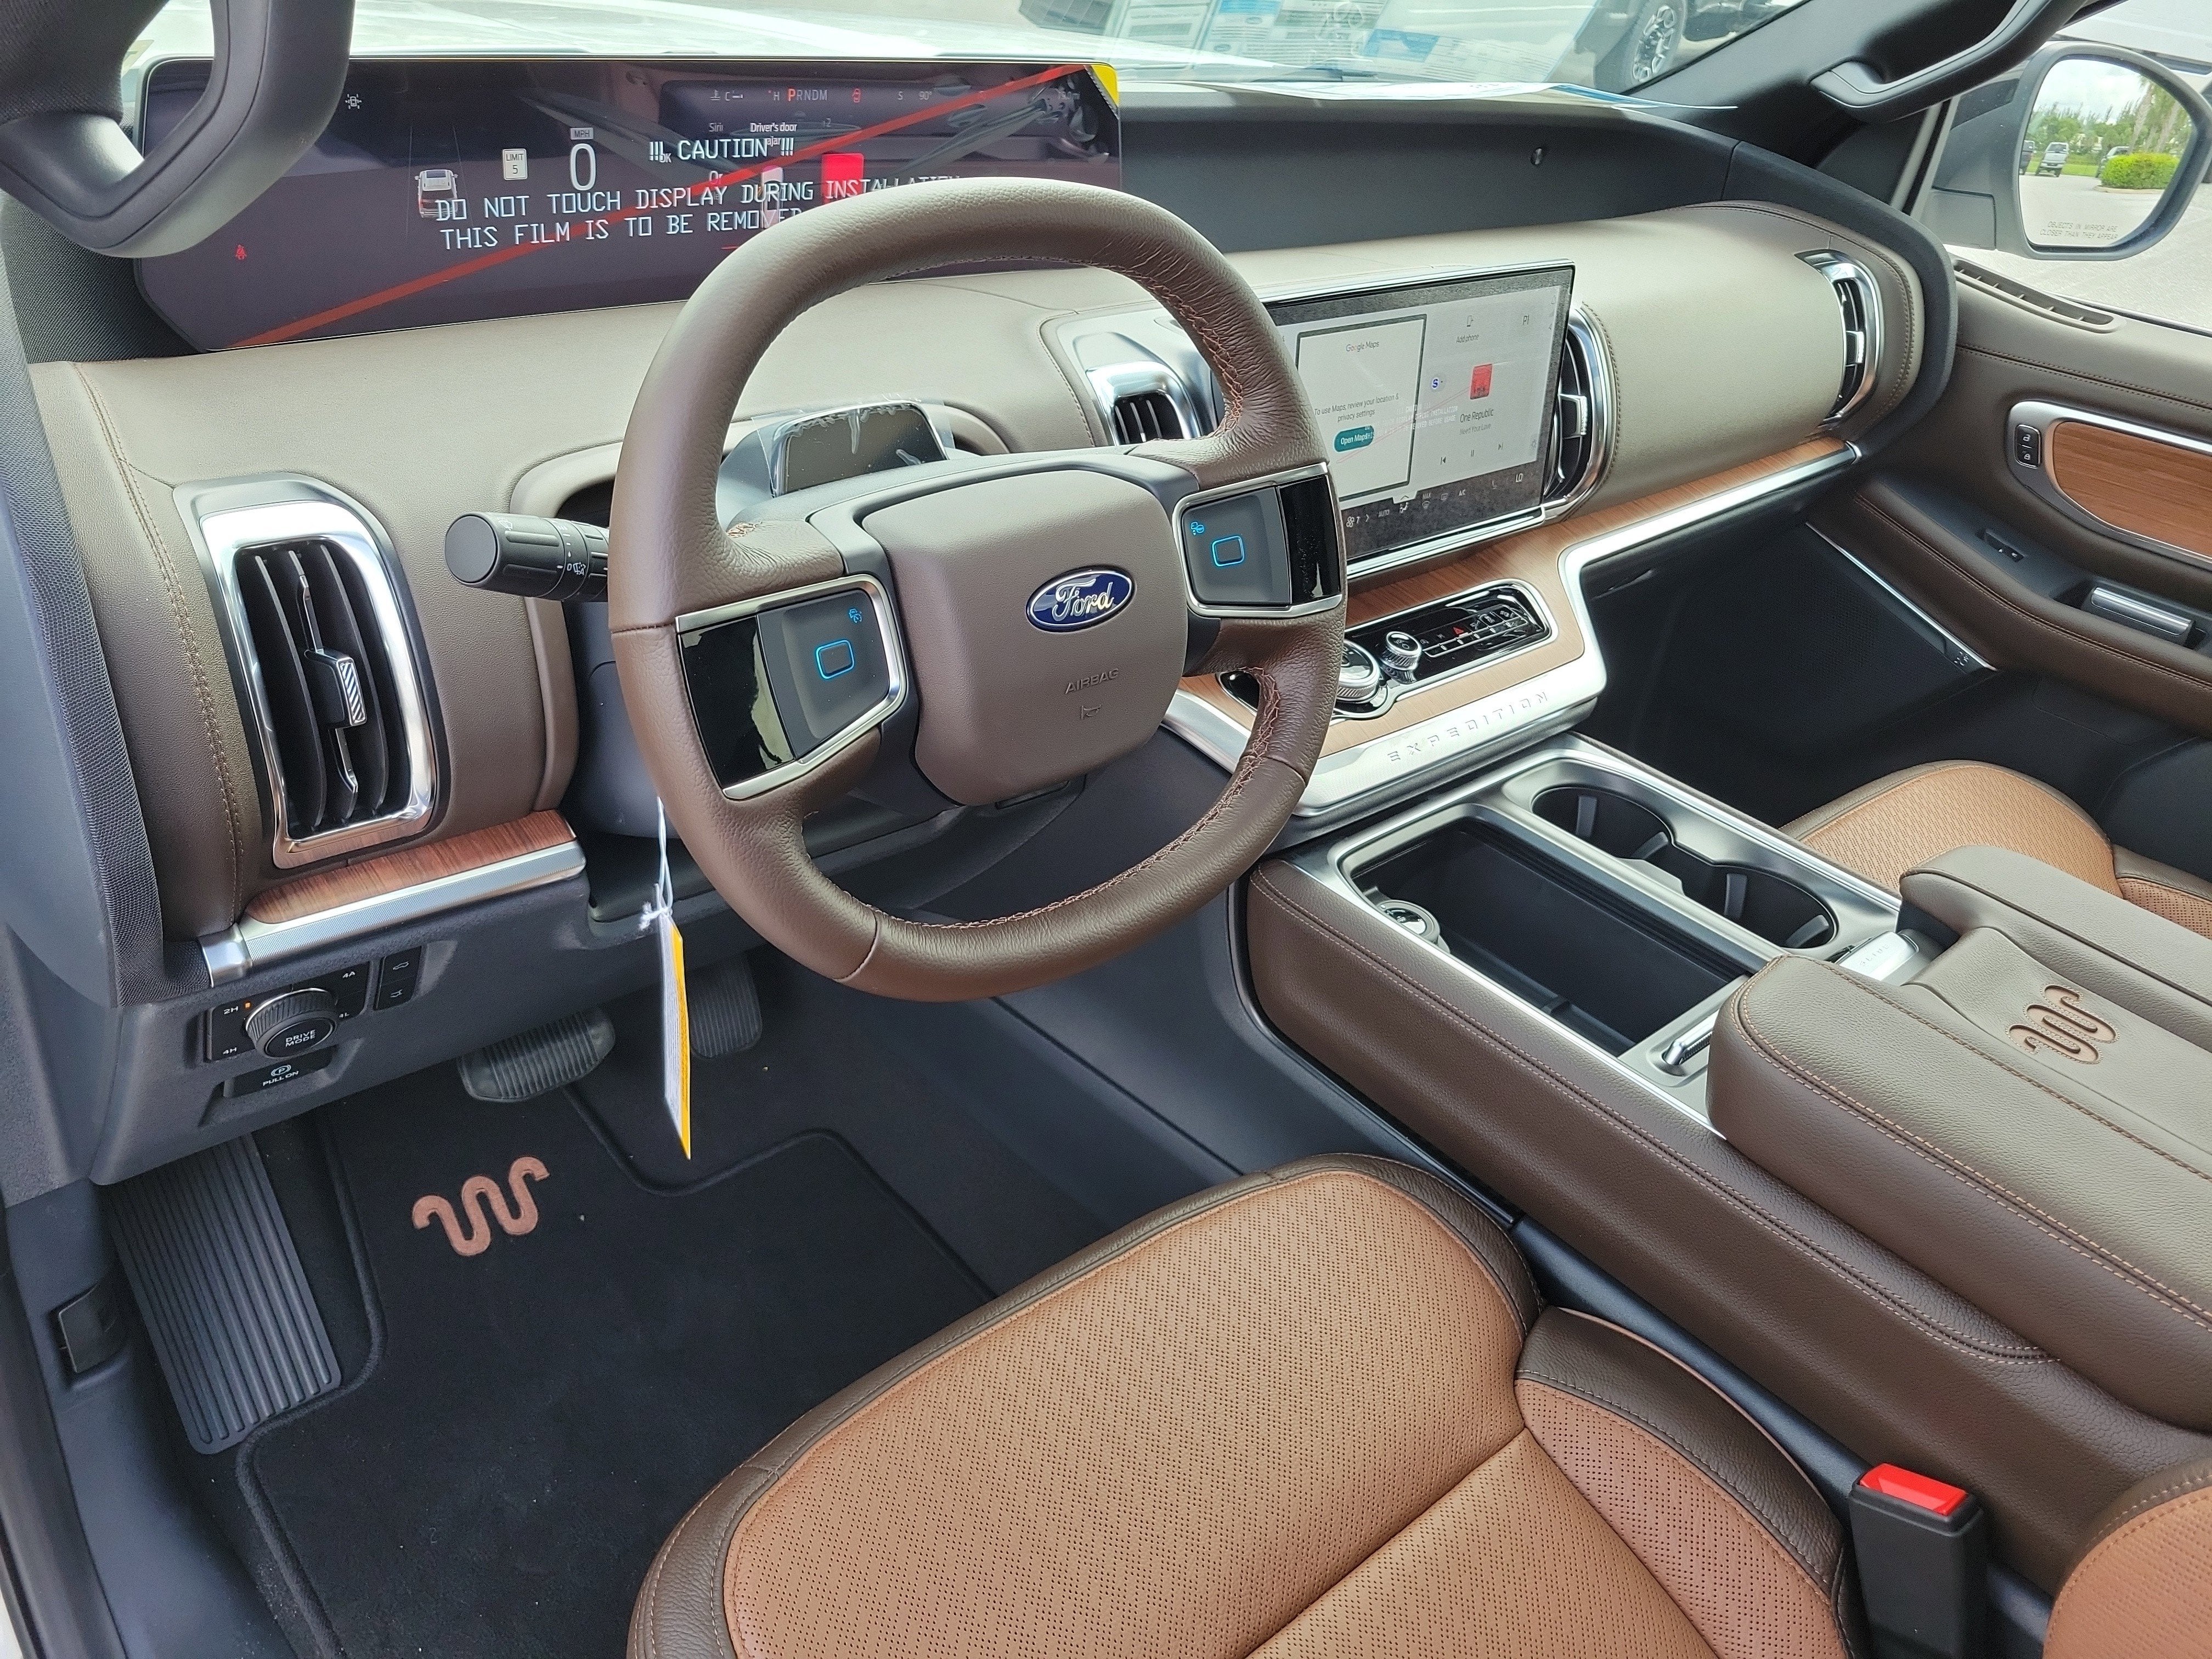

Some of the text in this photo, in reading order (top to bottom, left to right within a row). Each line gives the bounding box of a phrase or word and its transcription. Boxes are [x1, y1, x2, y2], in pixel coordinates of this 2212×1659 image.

[749, 122, 797, 132] Driver's door
[766, 136, 781, 148] ajar
[677, 138, 768, 160] CAUTION
[506, 153, 524, 161] LIMIT
[513, 165, 518, 174] 5
[569, 143, 596, 191] 0
[435, 199, 467, 221] DO
[484, 195, 529, 218] NOT
[546, 190, 621, 214] TOUCH
[635, 186, 727, 209] DISPLAY
[741, 181, 814, 204] DURING
[440, 226, 498, 250] THIS
[515, 222, 570, 245] FILM
[585, 219, 610, 240] IS
[624, 216, 652, 237] TO
[666, 214, 693, 235] BE
[1346, 341, 1379, 352] Google Maps
[1363, 398, 1375, 408] your
[1375, 395, 1395, 404] location
[1338, 409, 1375, 422] privacy settings
[1460, 408, 1494, 422] One Republic
[1340, 433, 1368, 445] Open Maps
[1515, 473, 1523, 483] LO
[1378, 509, 1390, 518] AUTO
[1051, 578, 1115, 622] Ford
[1065, 668, 1119, 695] AIRBAG
[1387, 691, 1548, 763] EXPEDITION
[223, 1006, 239, 1015] 2H
[285, 1029, 316, 1042] DRIVE
[285, 1034, 316, 1048] MODE
[223, 1047, 237, 1055] 4H
[263, 1070, 300, 1086] PULL ON
